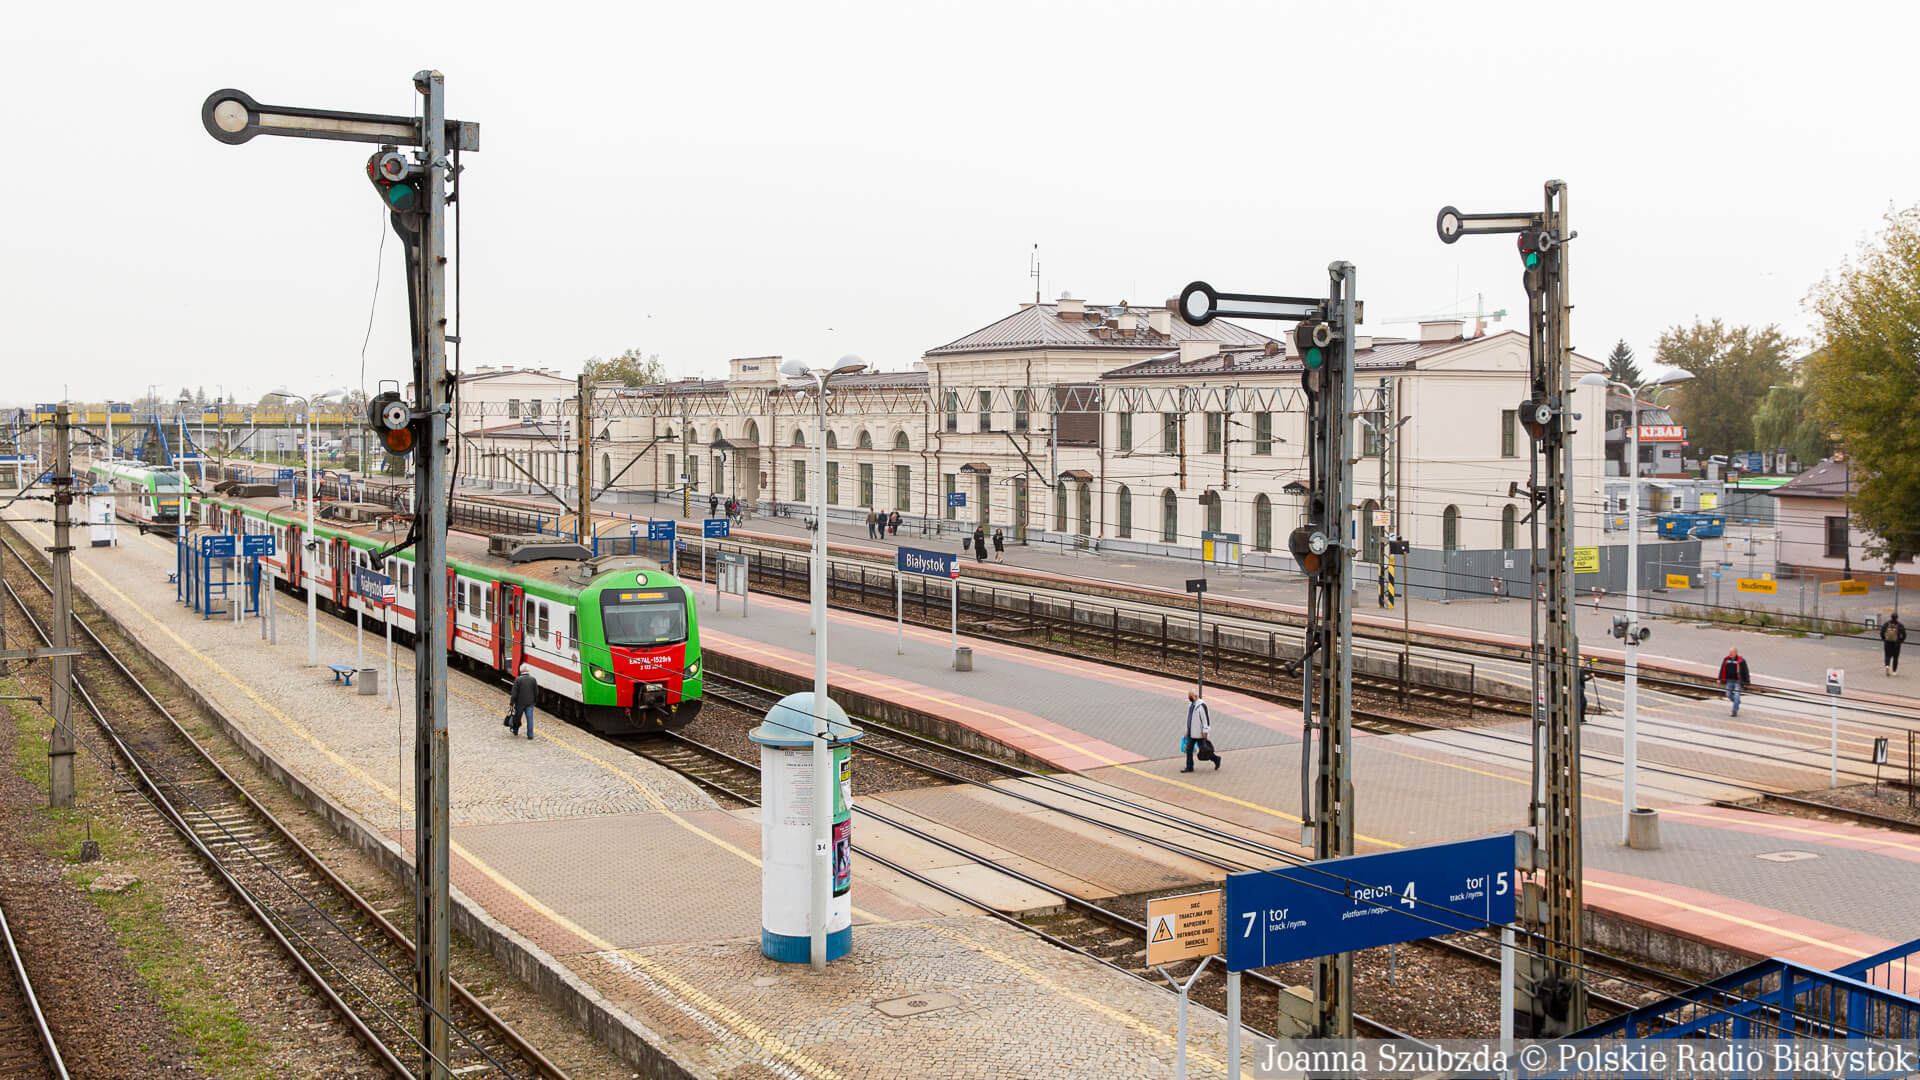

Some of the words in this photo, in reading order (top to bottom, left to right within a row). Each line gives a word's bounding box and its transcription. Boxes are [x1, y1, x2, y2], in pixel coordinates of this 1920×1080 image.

[1640, 427, 1682, 437] KEBAB
[204, 538, 211, 547] 4
[266, 538, 273, 546] 4
[204, 548, 211, 556] 7
[267, 547, 273, 555] 5
[906, 553, 945, 573] Białystok
[360, 574, 383, 597] Białystok
[1741, 581, 1772, 591] budimex
[1466, 876, 1484, 890] tor
[1495, 871, 1508, 896] 5
[1354, 884, 1393, 905] peron
[1400, 881, 1417, 909] 4
[1269, 908, 1289, 922] tor
[1242, 911, 1257, 938] 7
[1269, 921, 1286, 932] track
